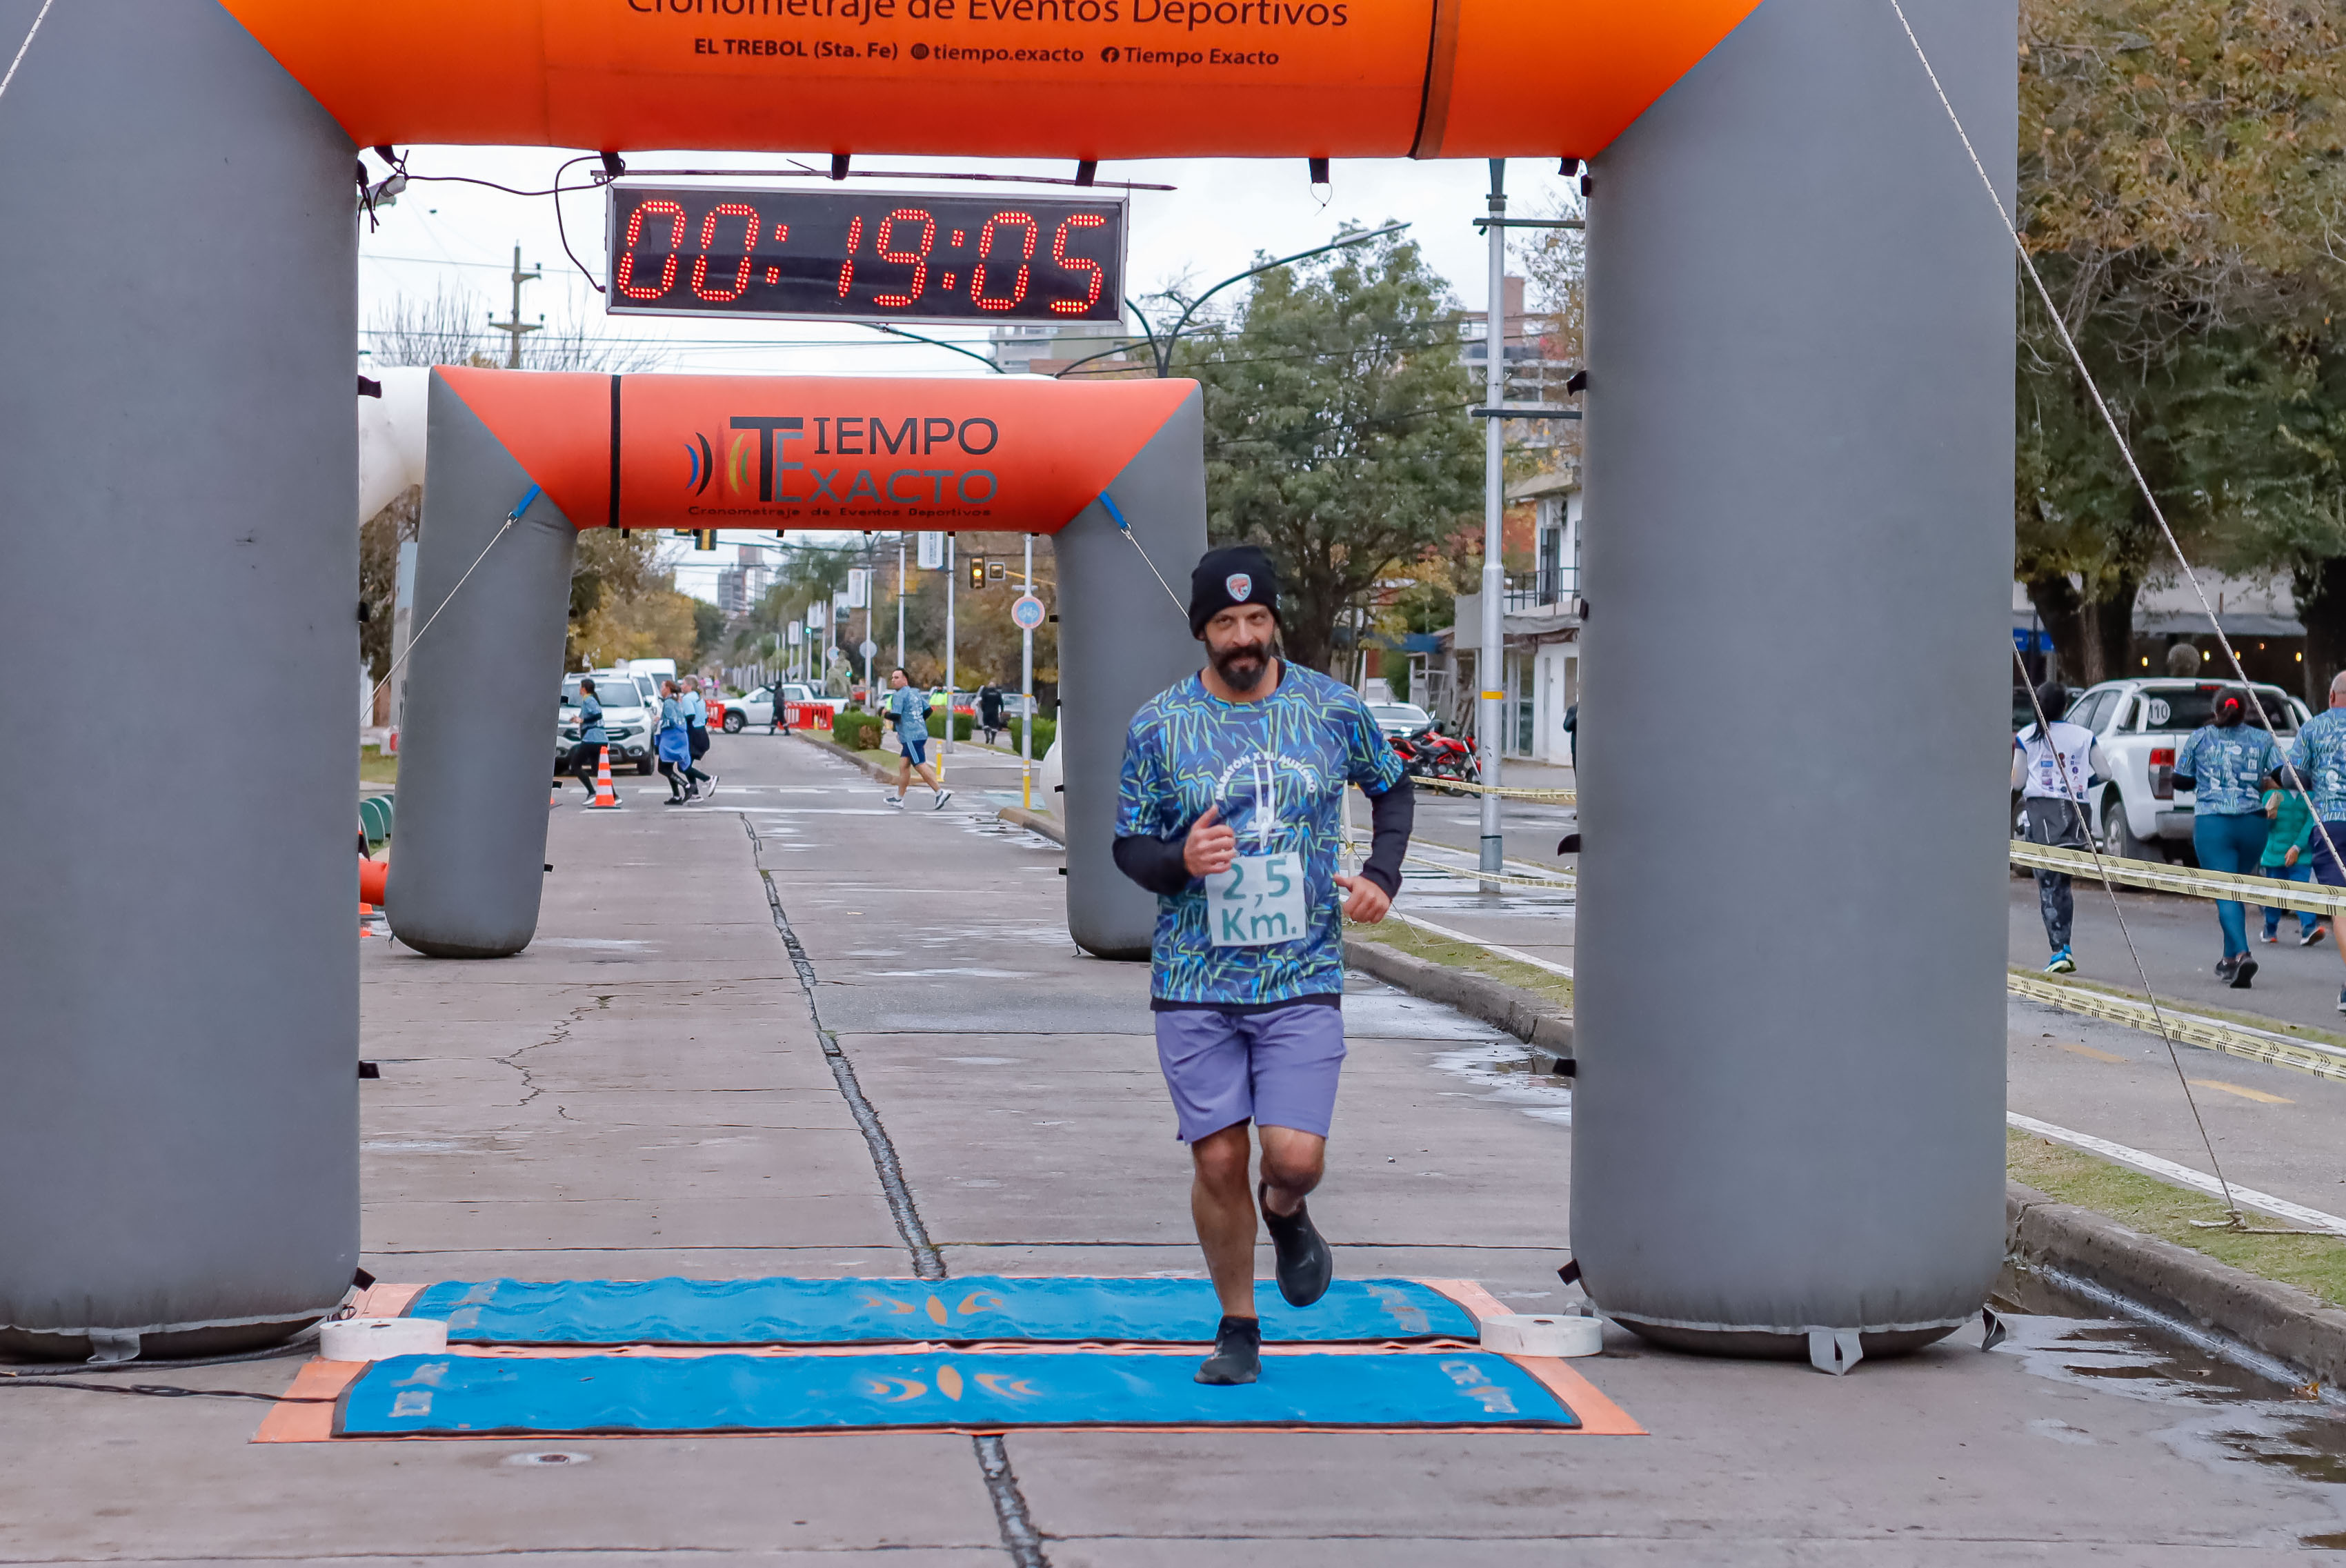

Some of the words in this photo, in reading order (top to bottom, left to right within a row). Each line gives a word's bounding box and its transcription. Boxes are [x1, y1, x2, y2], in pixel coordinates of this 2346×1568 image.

[908, 0, 955, 19] de
[969, 0, 1120, 22] Eventos
[1133, 0, 1347, 31] Deportivos
[694, 38, 719, 54] EL
[724, 39, 808, 57] TREBOL
[813, 41, 862, 59] (Sta.
[866, 42, 898, 59] Fe)
[933, 45, 1084, 63] tiempo.exacto
[1124, 46, 1204, 68] Tiempo
[1209, 48, 1280, 66] Exacto
[730, 416, 999, 502] TIEMPO
[774, 432, 998, 504] EXACTO
[688, 506, 801, 519] Cronometraje
[811, 506, 831, 517] de
[839, 507, 901, 517] Eventos
[908, 507, 992, 519] Deportivos
[2149, 704, 2168, 720] 110
[1222, 858, 1291, 909] 2,5
